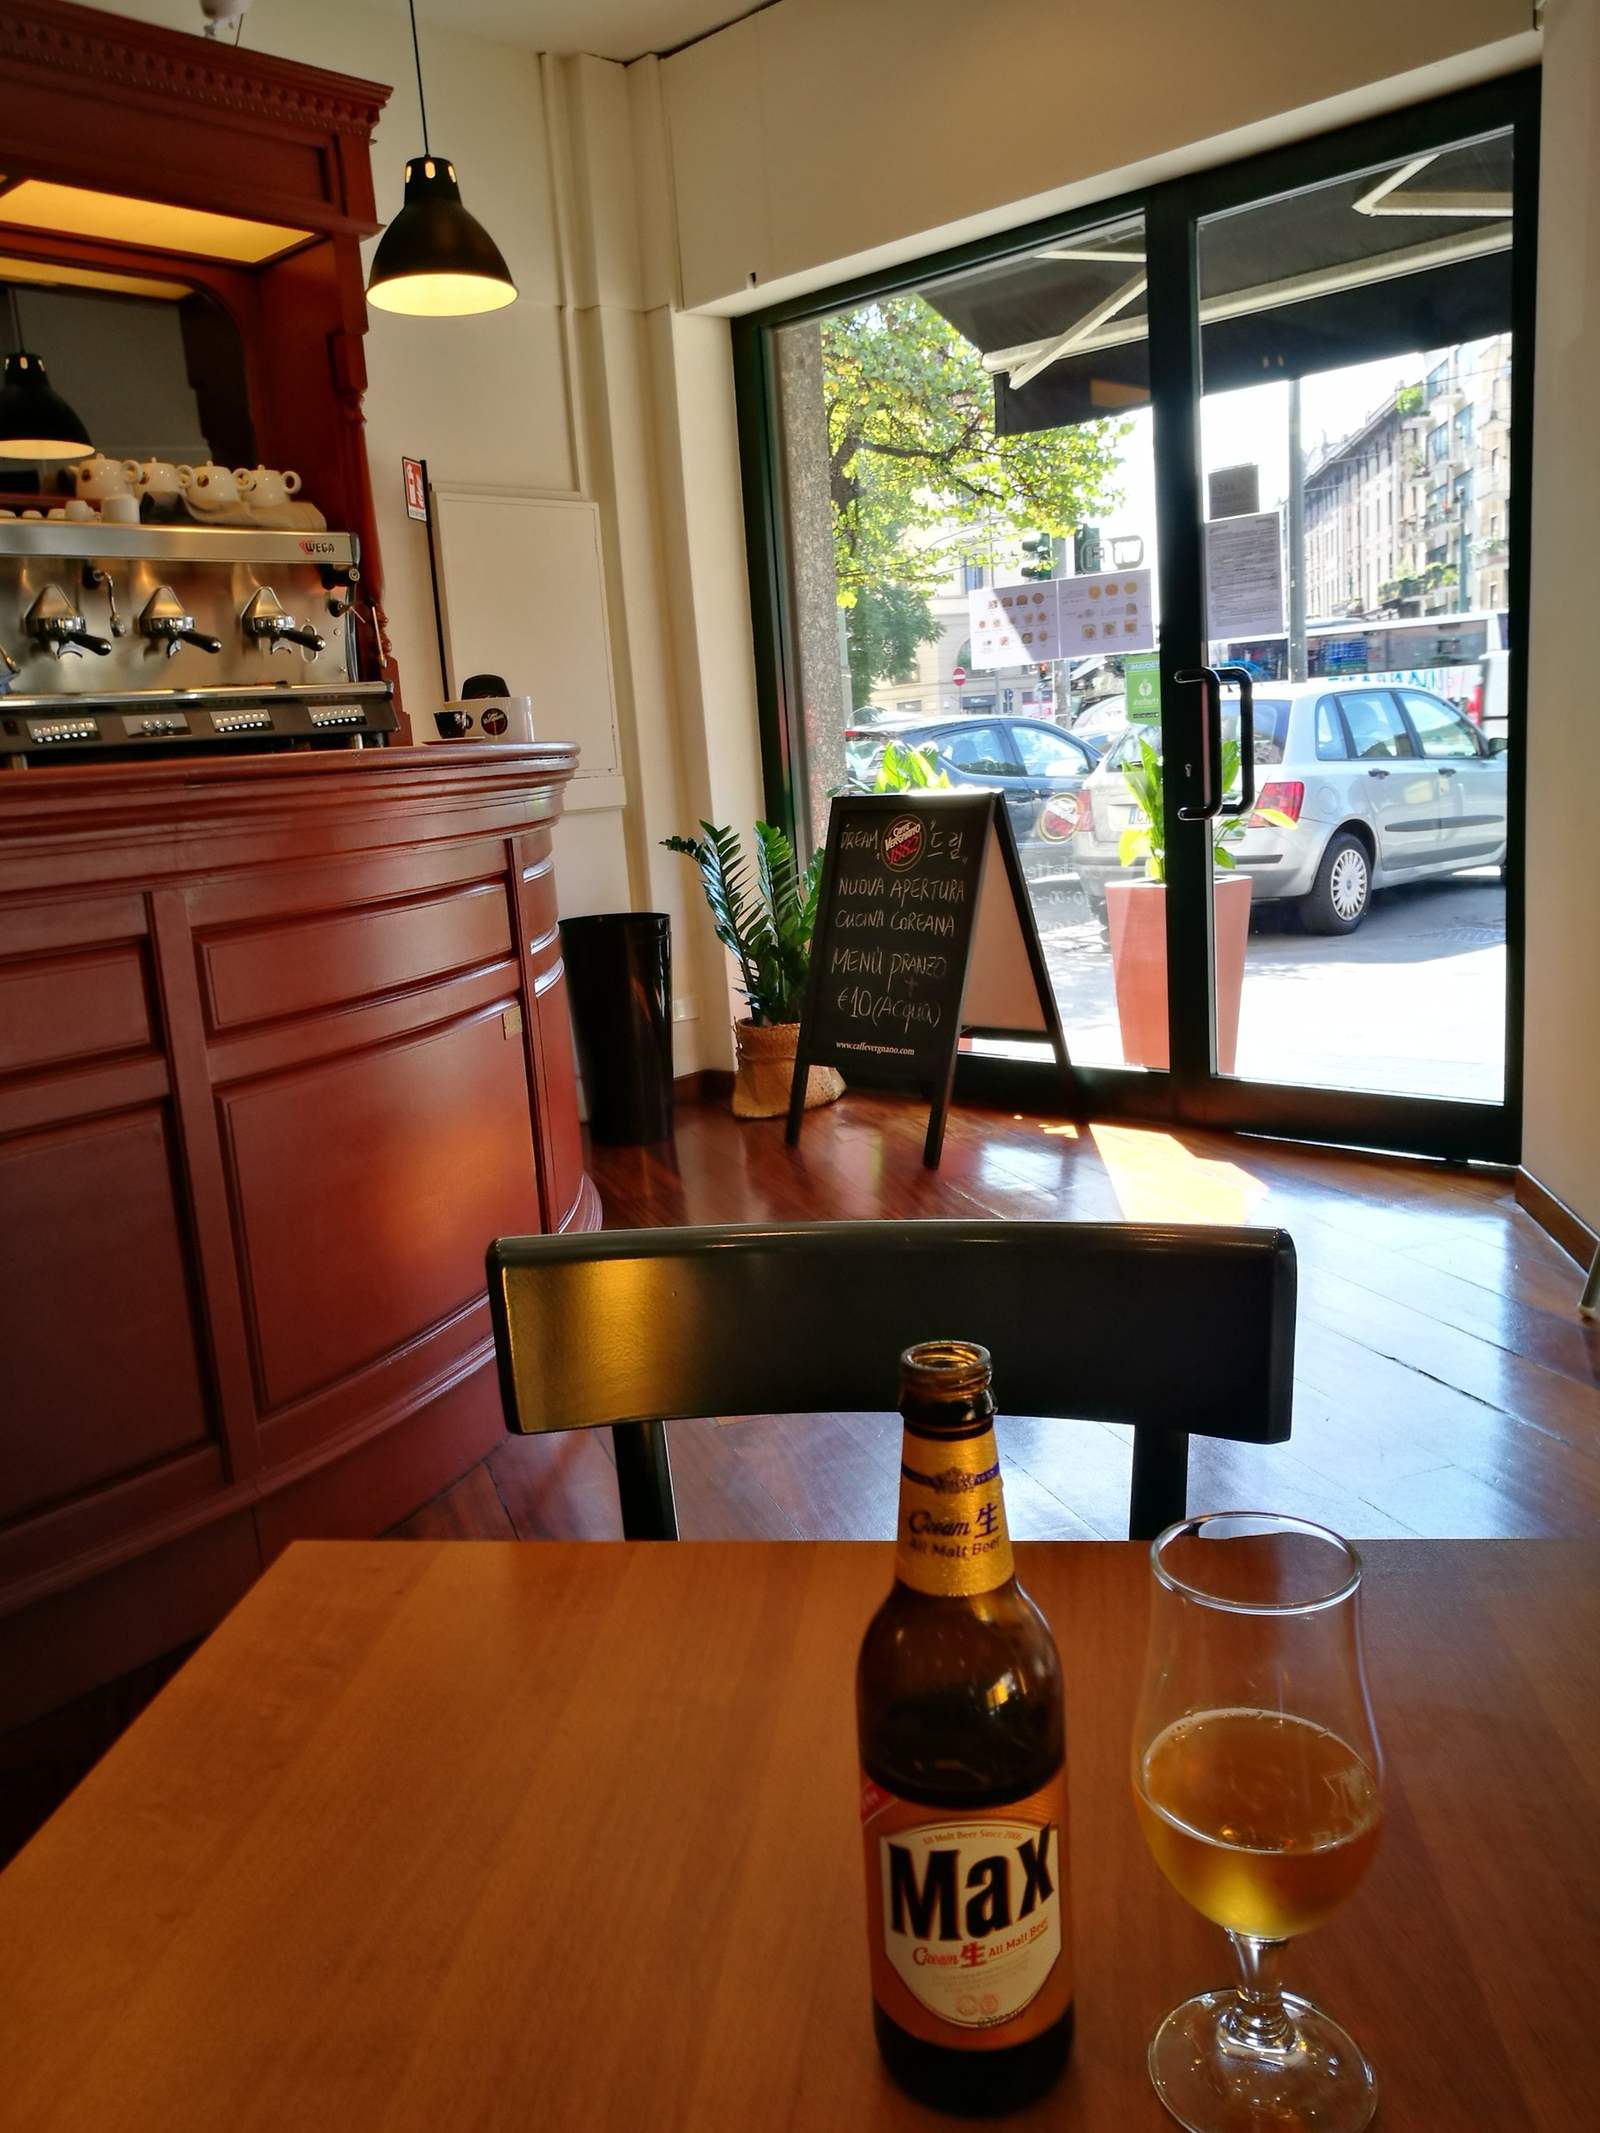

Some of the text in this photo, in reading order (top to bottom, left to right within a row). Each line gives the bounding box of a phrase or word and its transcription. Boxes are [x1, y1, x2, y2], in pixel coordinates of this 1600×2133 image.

[304, 542, 335, 553] WEGA
[838, 878, 966, 907] NUOVA APERTURA
[835, 1041, 915, 1056] www.caffevergnano.com
[974, 1502, 1000, 1539] 生
[932, 1541, 967, 1558] Malt
[971, 1535, 1001, 1556] Beer
[887, 1822, 1055, 1942] Max
